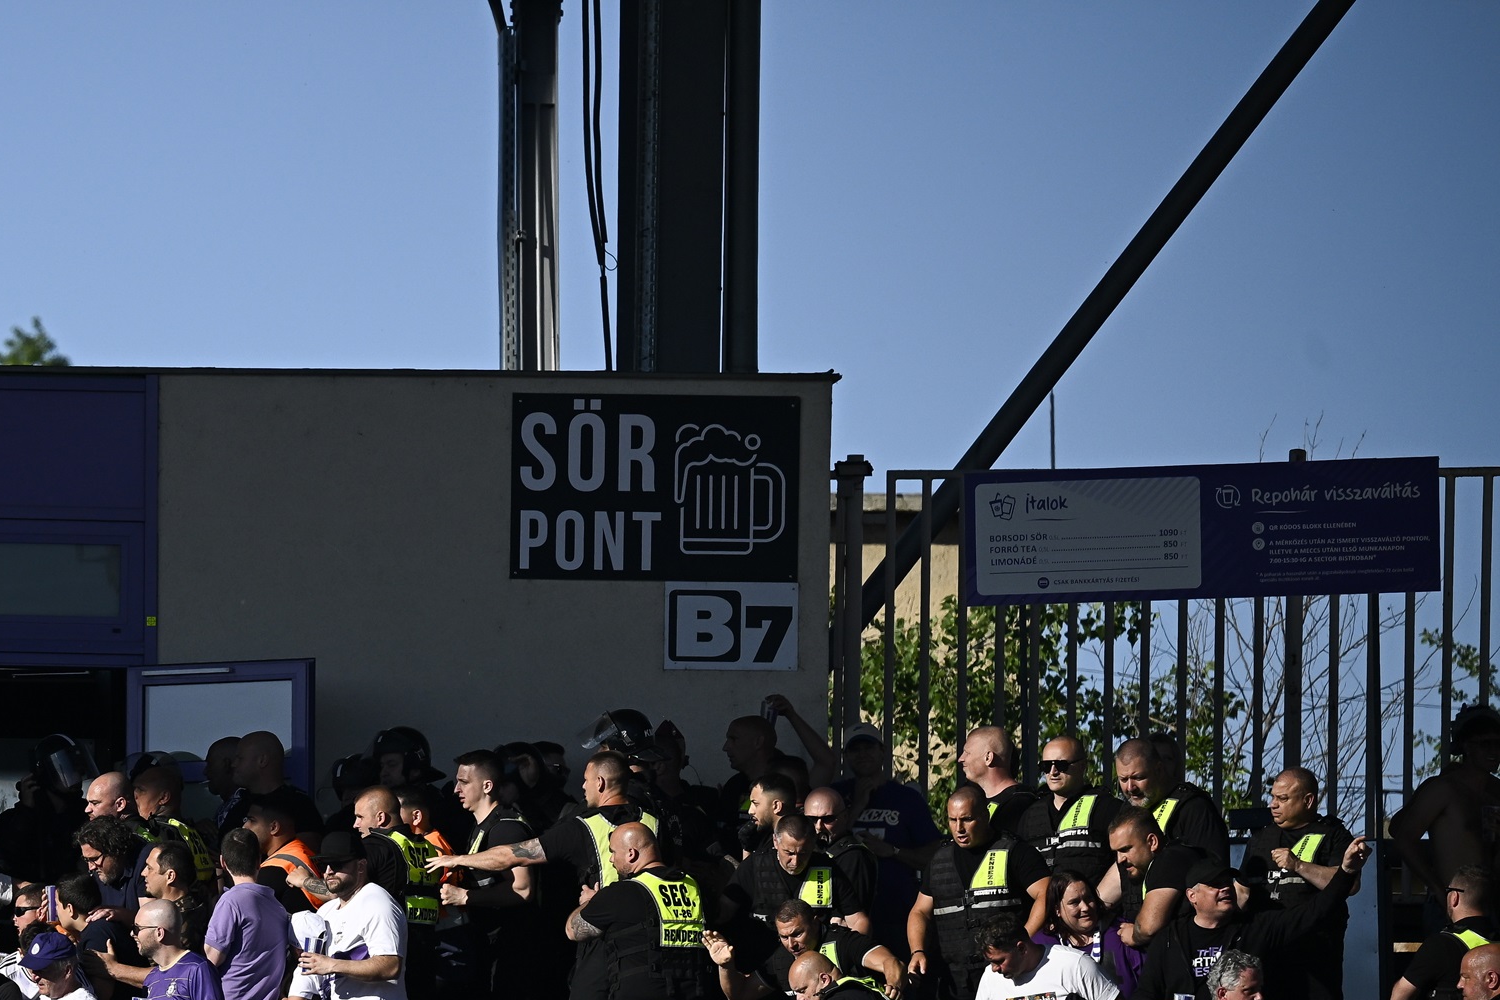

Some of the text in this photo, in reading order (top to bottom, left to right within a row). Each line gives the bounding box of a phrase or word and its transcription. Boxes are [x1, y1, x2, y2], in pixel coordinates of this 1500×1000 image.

[520, 399, 656, 492] SÖR
[1251, 481, 1420, 506] Repohár visszaváltás
[519, 509, 661, 571] PONT
[989, 533, 1028, 543] BORSODI
[1030, 532, 1048, 541] SÖR
[1159, 528, 1178, 537] 1090
[1308, 537, 1326, 545] UTÁN
[989, 545, 1019, 554] FORRÓ
[1021, 545, 1037, 553] TEA
[1163, 540, 1178, 548] 850
[991, 556, 1037, 567] LIMONÁDÉ
[1164, 552, 1178, 561] 850
[858, 808, 899, 826] KERS
[658, 884, 696, 907] SEC.
[672, 909, 692, 919] V-26
